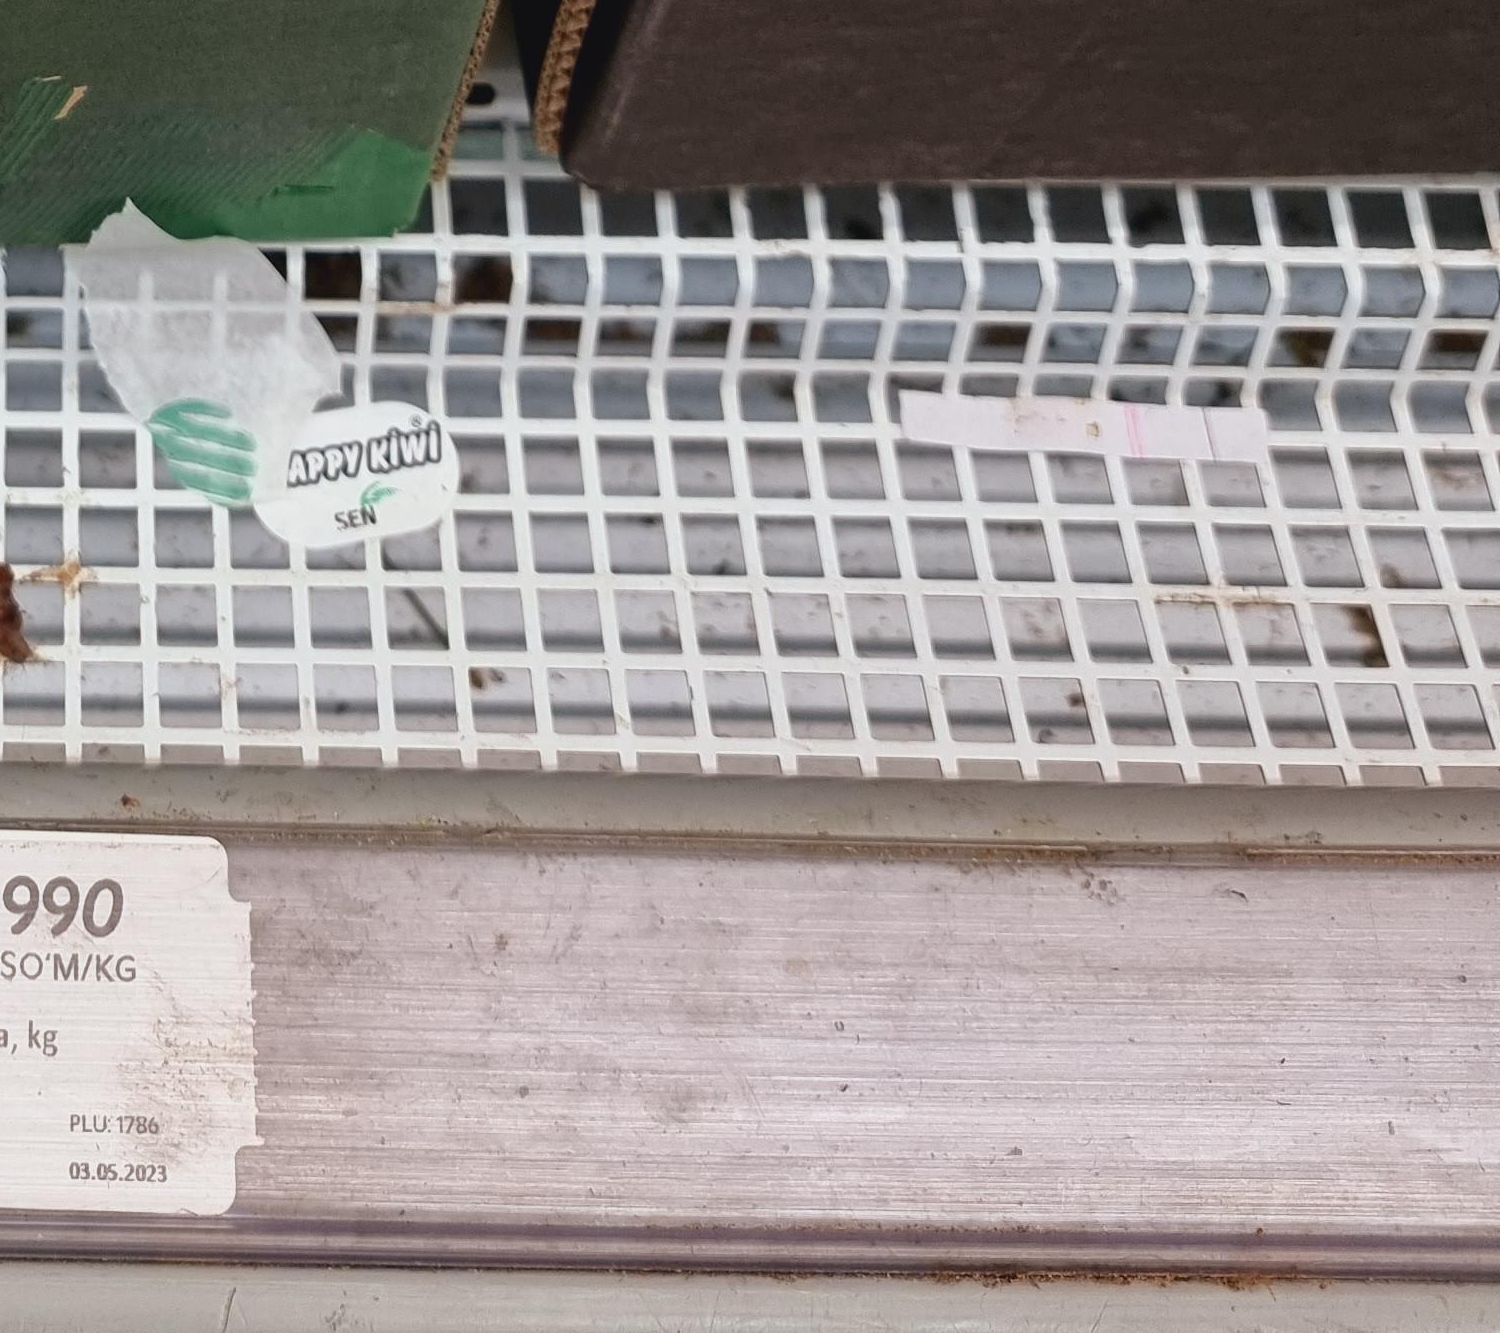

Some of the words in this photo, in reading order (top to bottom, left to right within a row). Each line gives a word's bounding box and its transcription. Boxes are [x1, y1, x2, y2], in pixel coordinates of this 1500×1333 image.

[2, 874, 125, 938] 990
[26, 1020, 59, 1057] kg
[69, 1114, 112, 1134] PLU:
[115, 1115, 160, 1135] 1786
[68, 1162, 168, 1183] 03.05.2023
